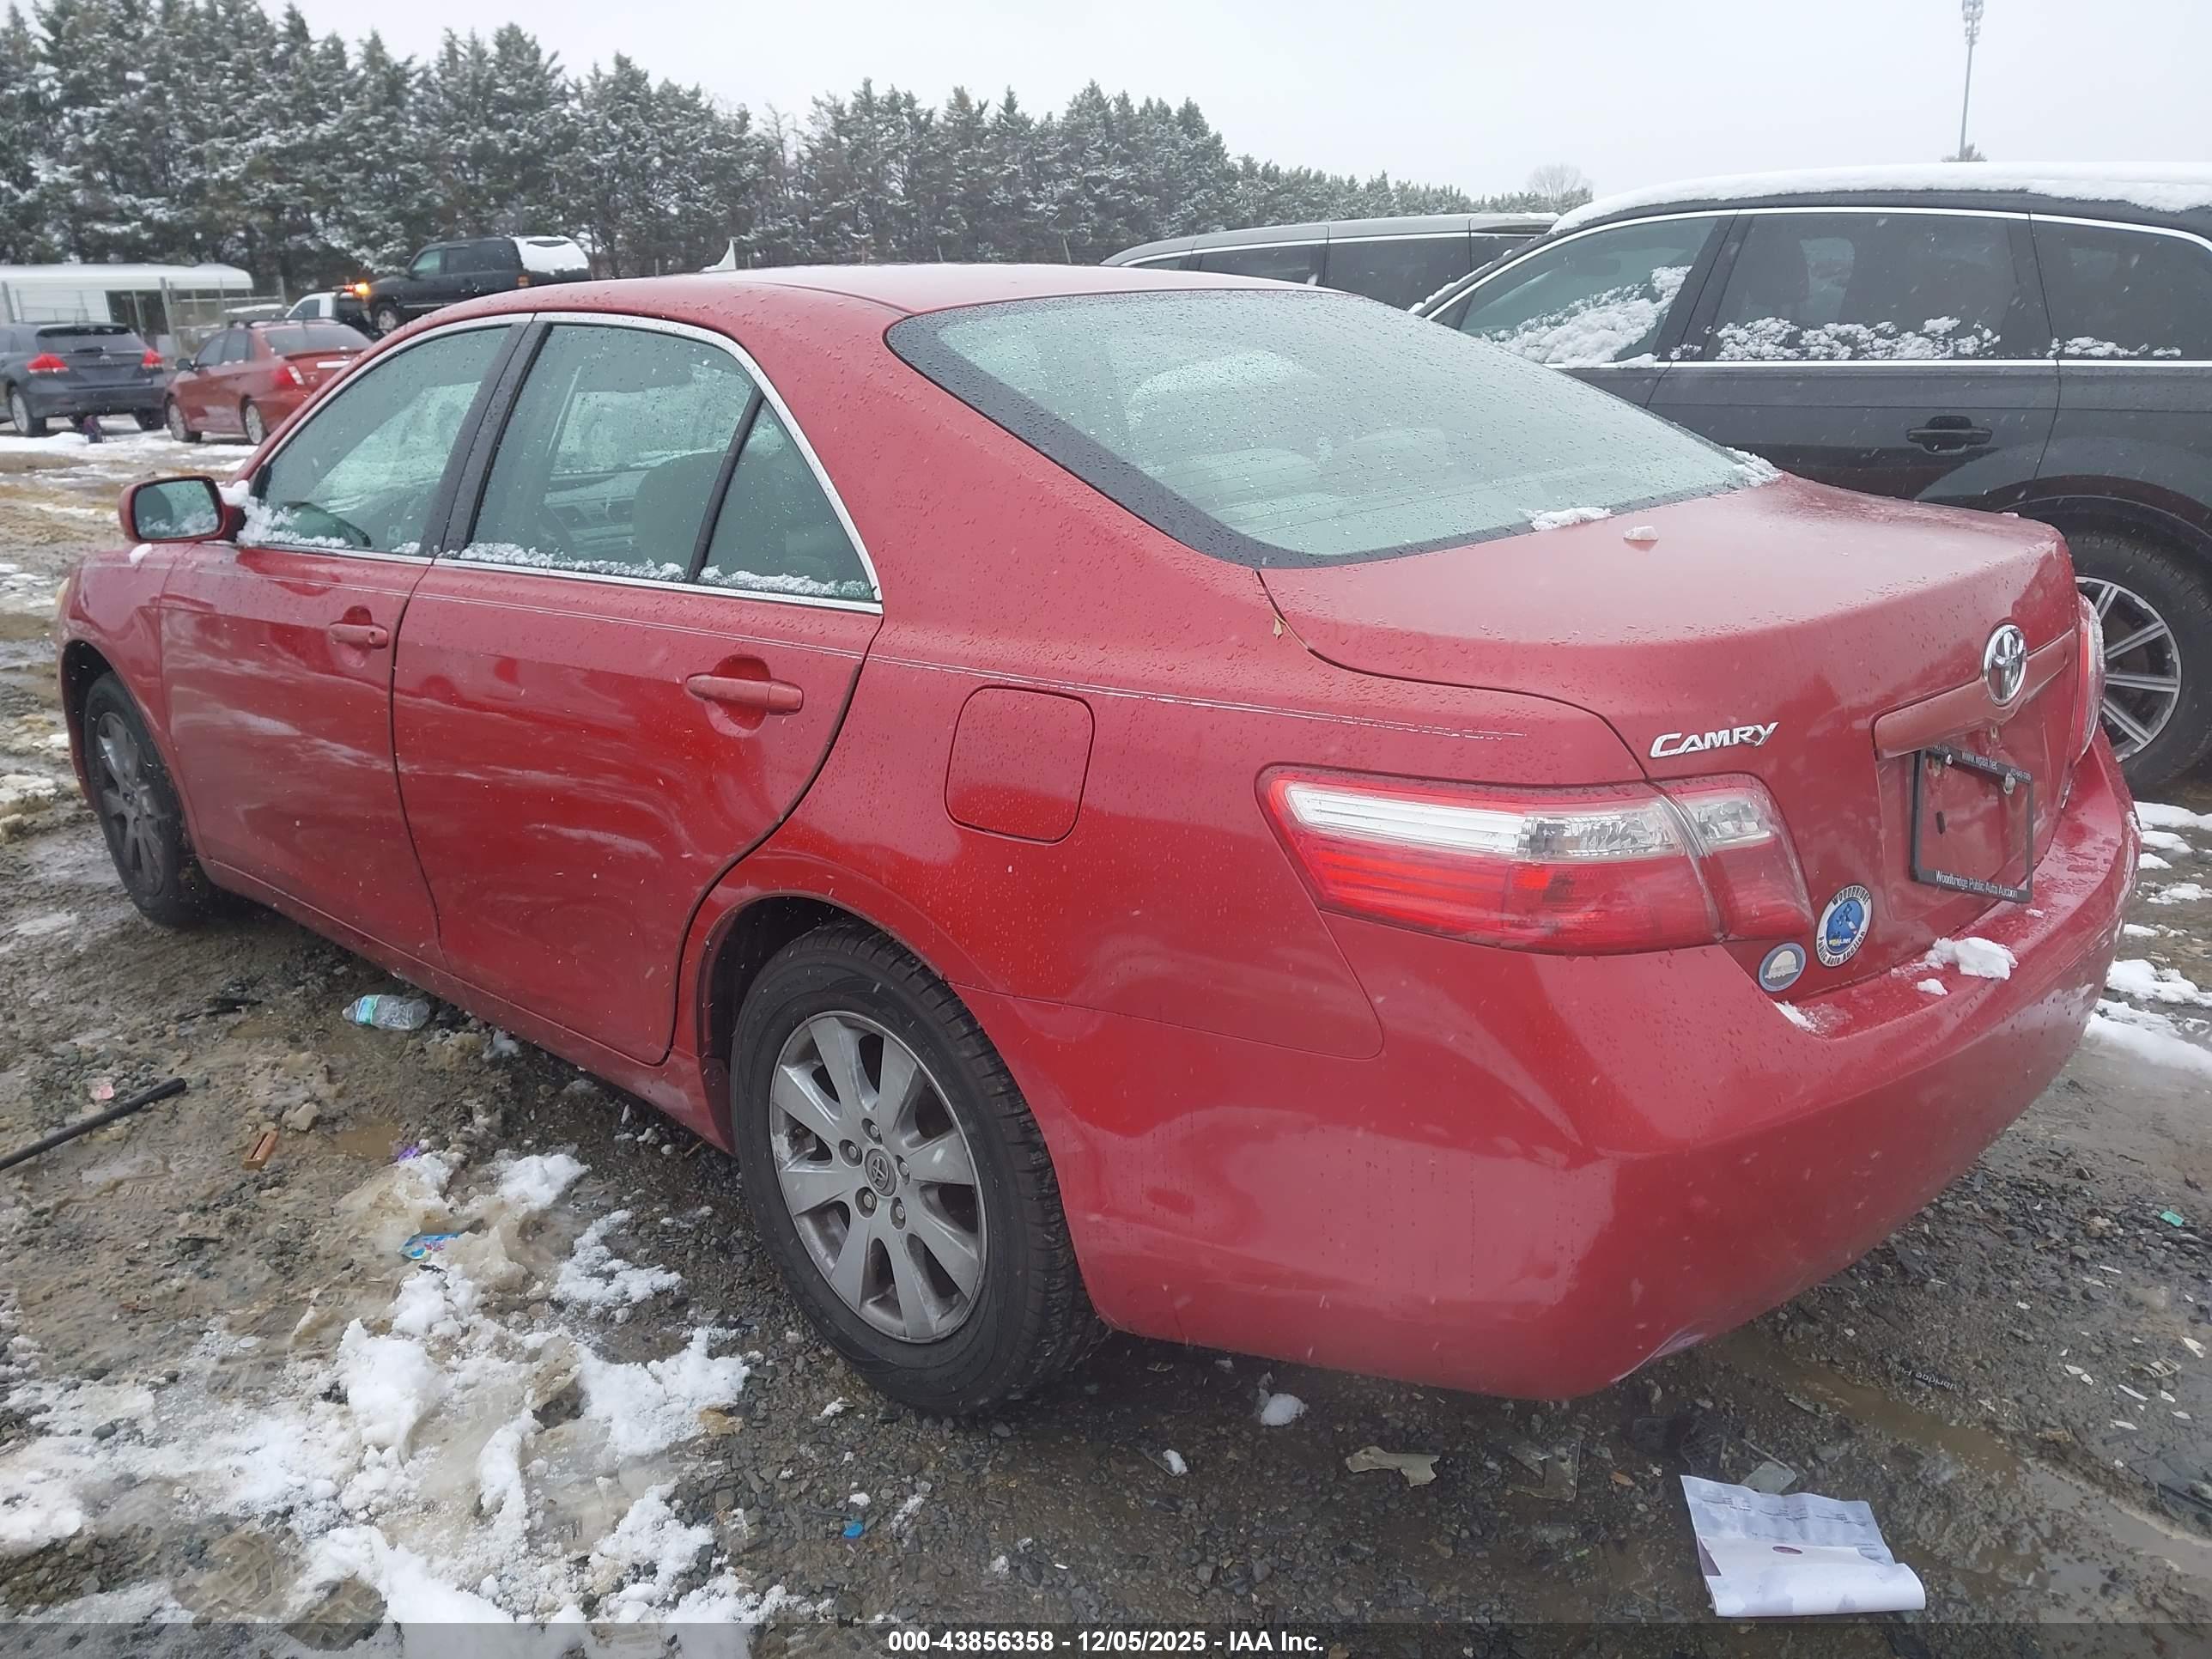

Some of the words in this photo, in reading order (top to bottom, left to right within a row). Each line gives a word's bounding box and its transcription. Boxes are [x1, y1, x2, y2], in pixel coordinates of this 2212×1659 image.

[1650, 721, 1780, 758] CAMRY
[1832, 886, 1870, 906] WOODBRIDGE
[1936, 869, 1968, 890] Woodbridge
[1969, 878, 1984, 892] Public
[1985, 882, 1998, 895] Auto
[1999, 884, 2018, 898] Auction
[1818, 935, 1828, 962] Public
[1827, 955, 1841, 965] Auto
[1842, 931, 1866, 961] Auction
